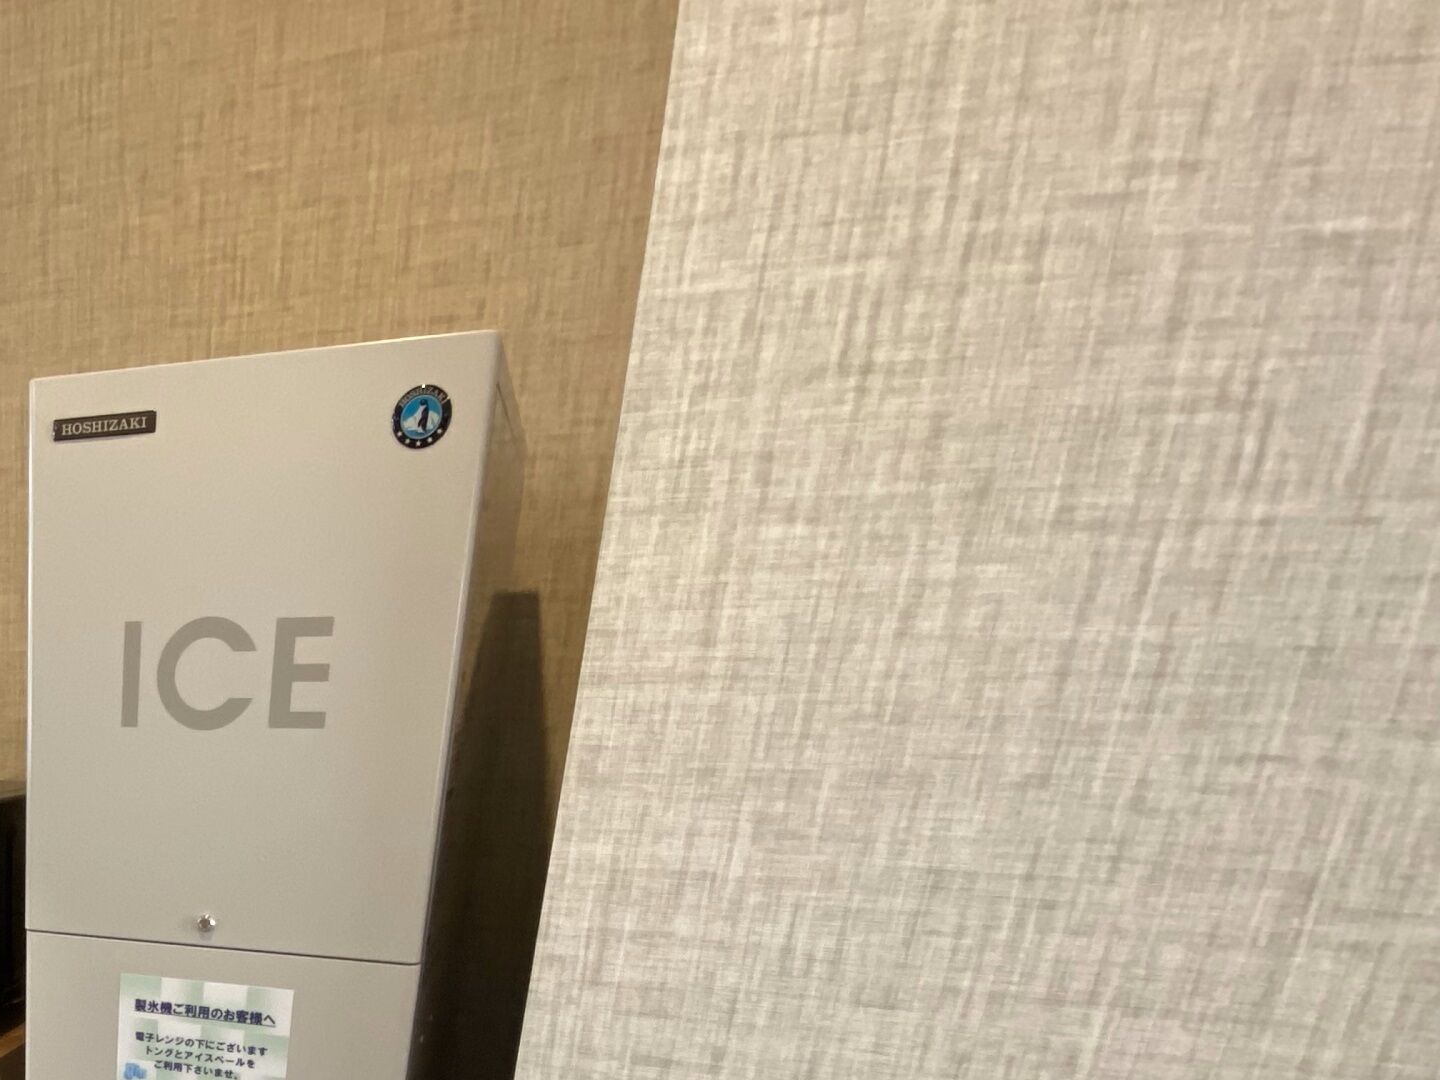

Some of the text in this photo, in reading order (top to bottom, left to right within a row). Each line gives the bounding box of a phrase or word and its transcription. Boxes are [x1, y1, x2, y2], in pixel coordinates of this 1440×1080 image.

[60, 415, 148, 436] HOSHIZAKI
[120, 615, 335, 731] ICE
[133, 998, 276, 1027] 製氷機ご利用のお客様へ
[134, 1031, 268, 1056] 電子レンジの下にございます
[145, 1045, 256, 1069] トングとアイスペールを
[153, 1059, 239, 1080] ご利用下さいませ。
